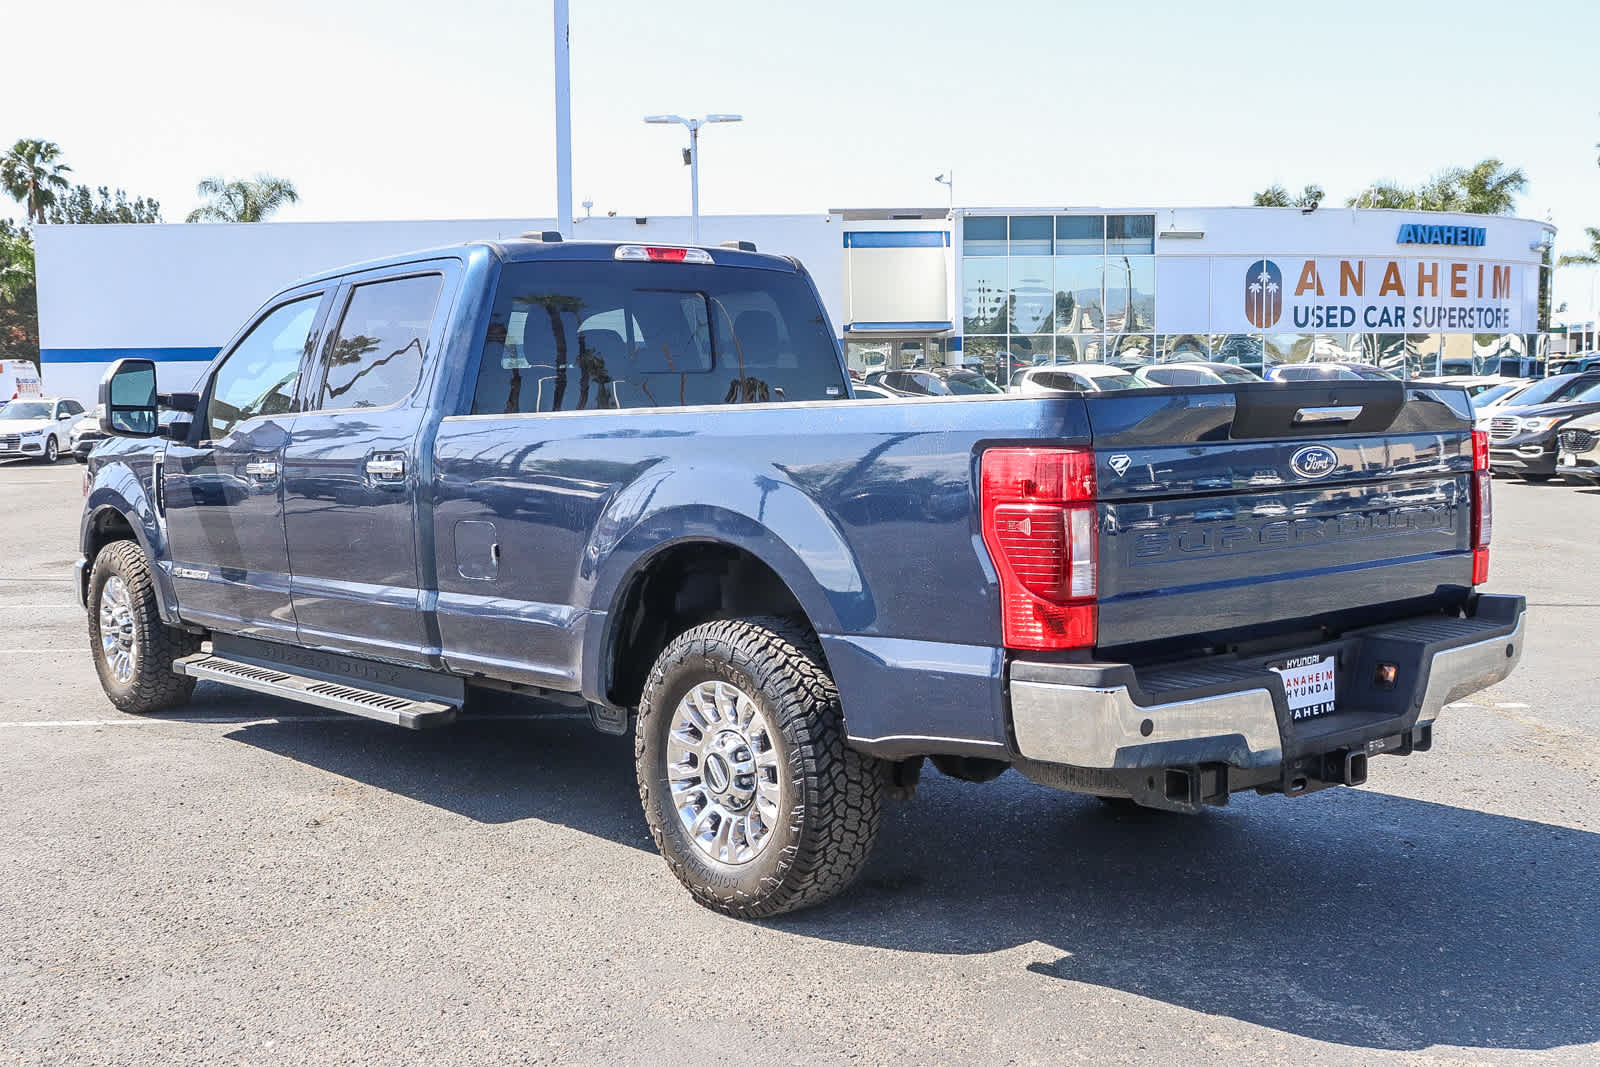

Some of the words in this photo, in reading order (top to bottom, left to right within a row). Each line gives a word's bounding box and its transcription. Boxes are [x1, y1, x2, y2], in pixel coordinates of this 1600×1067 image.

[1397, 223, 1486, 246] ANAHEIM
[1294, 260, 1511, 299] ANAHEIM
[1293, 305, 1356, 328] USED
[1363, 305, 1406, 328] CAR
[1412, 305, 1510, 329] SUPERSTORE
[1304, 452, 1330, 471] Ford
[1286, 654, 1320, 669] HYUNDAI
[1286, 670, 1333, 688] ANAHEIM
[1286, 682, 1333, 699] HYUNDAI
[1290, 701, 1335, 720] AHEIM
